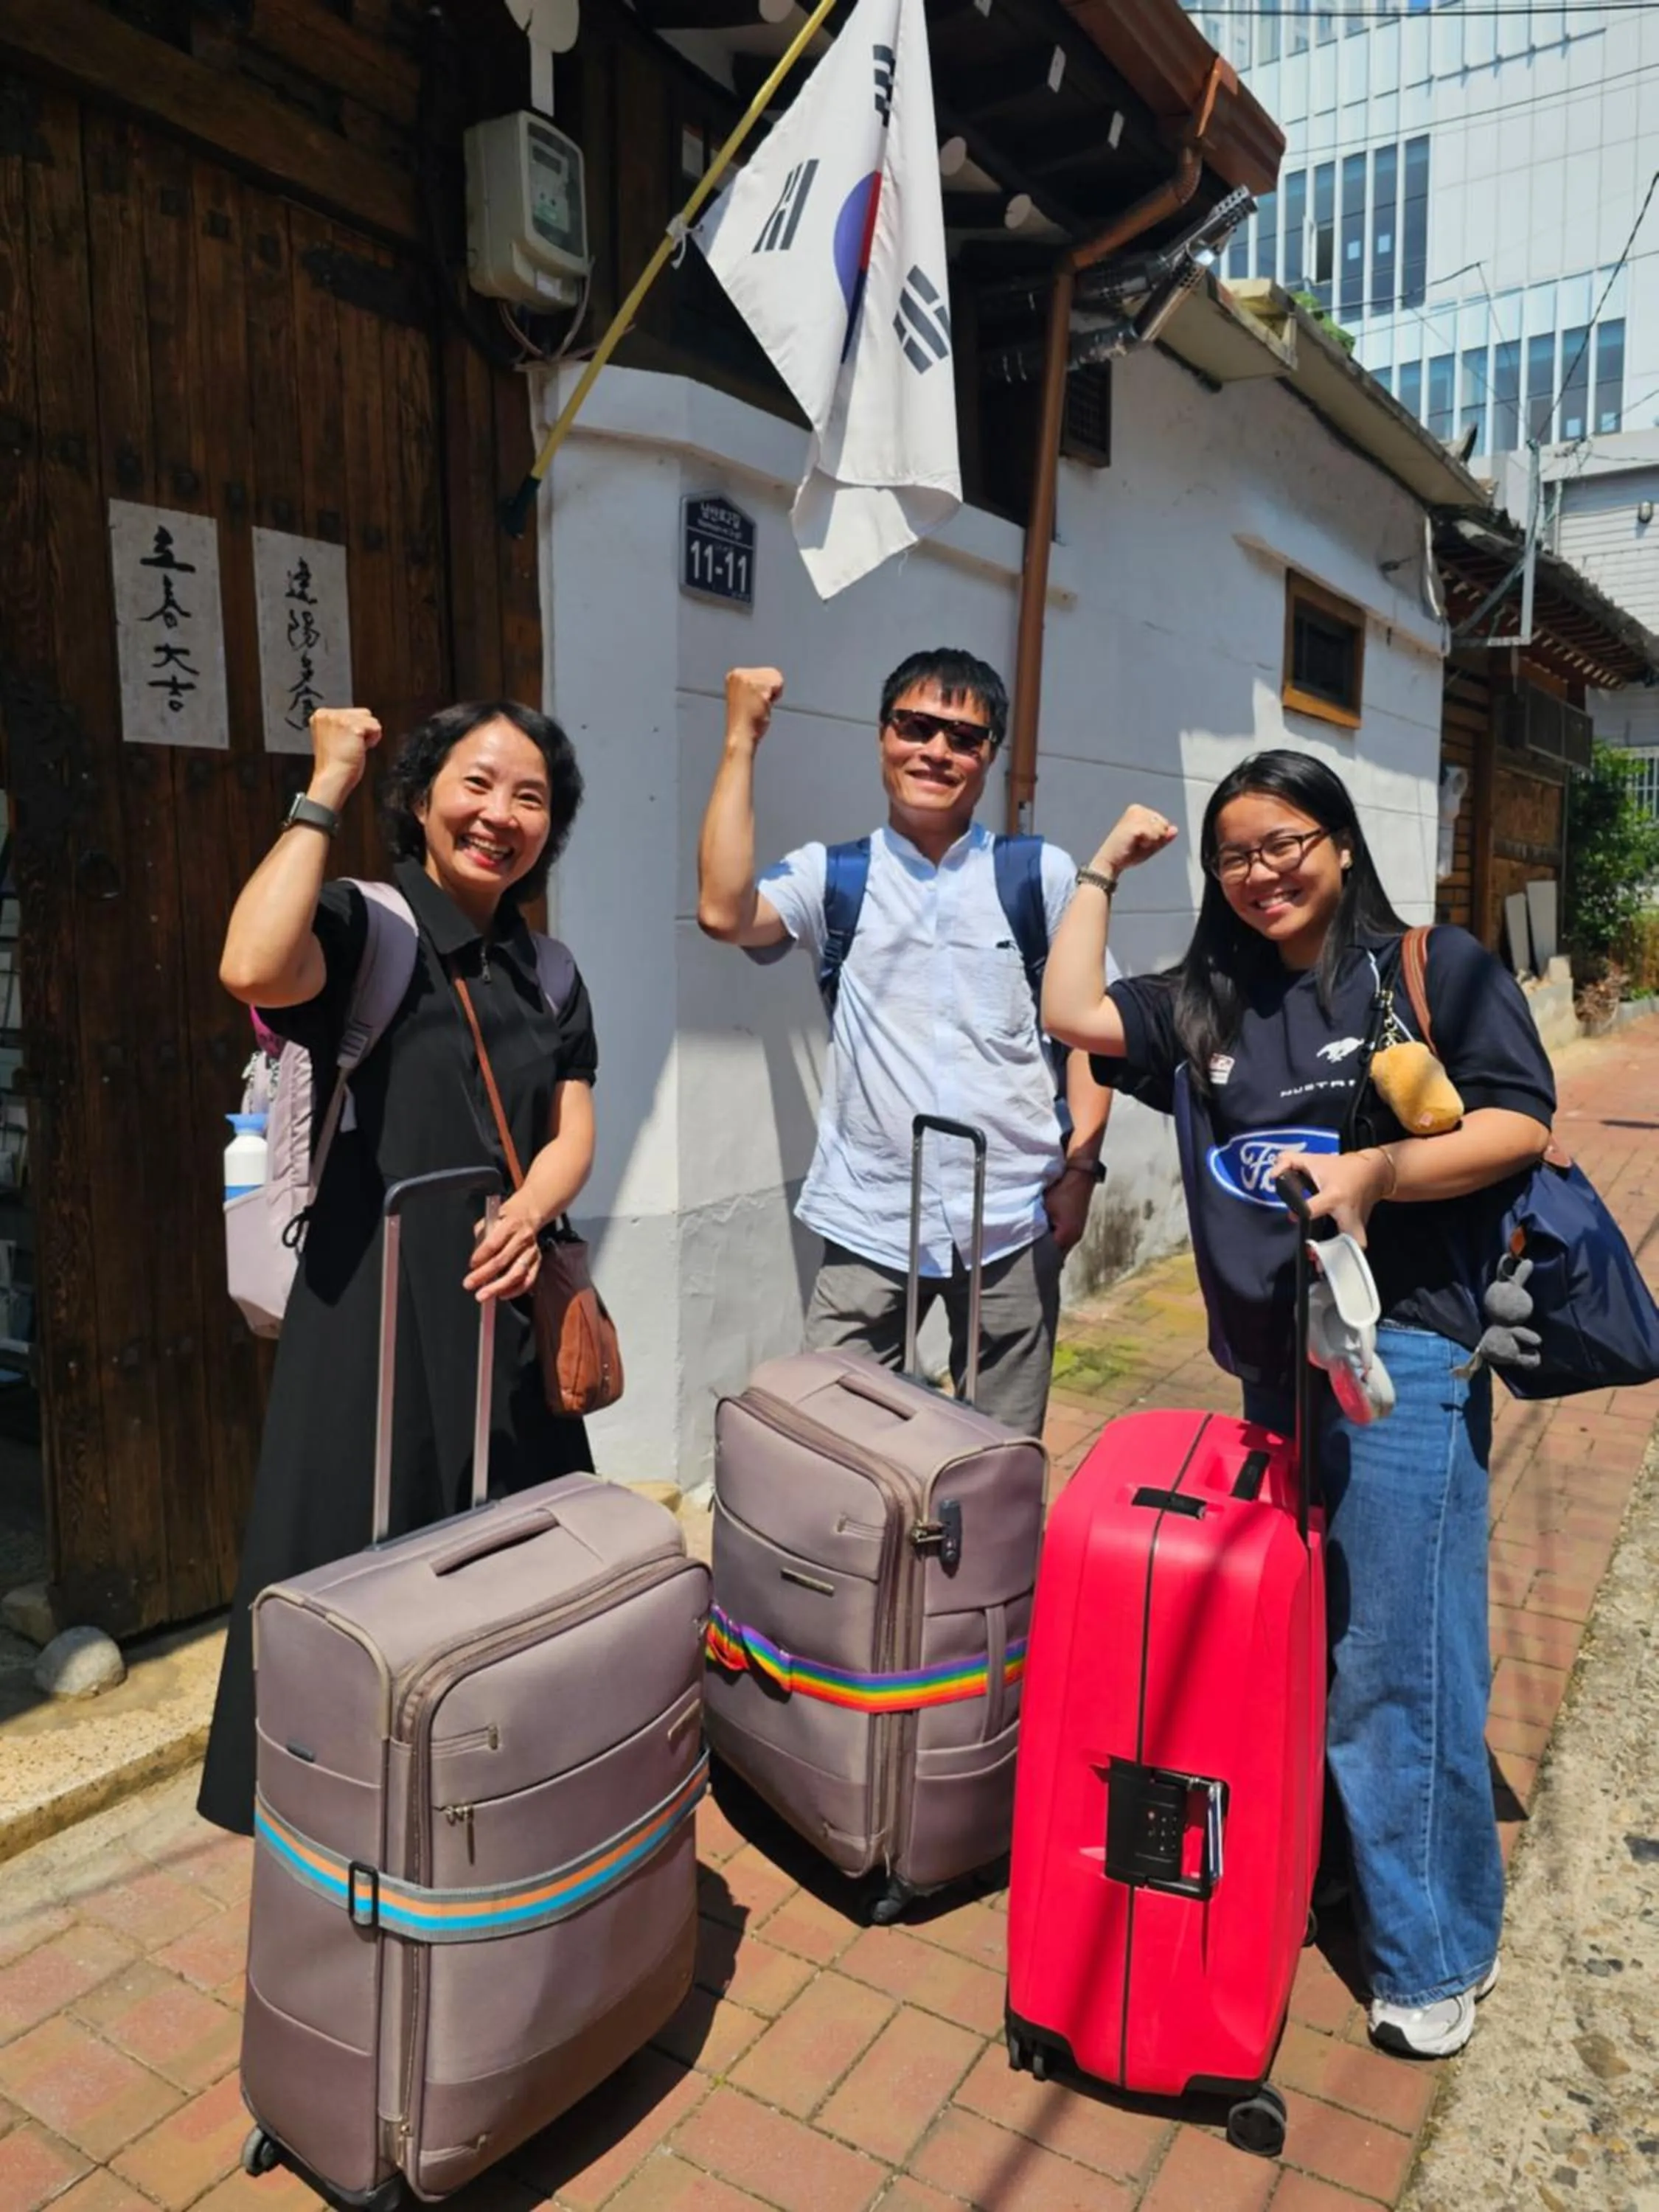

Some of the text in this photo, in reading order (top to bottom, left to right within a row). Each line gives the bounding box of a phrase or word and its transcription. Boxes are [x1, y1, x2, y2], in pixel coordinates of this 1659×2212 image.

[690, 539, 747, 594] 11-11
[137, 524, 200, 712] 立春大吉
[1279, 1079, 1356, 1098] MUSTA
